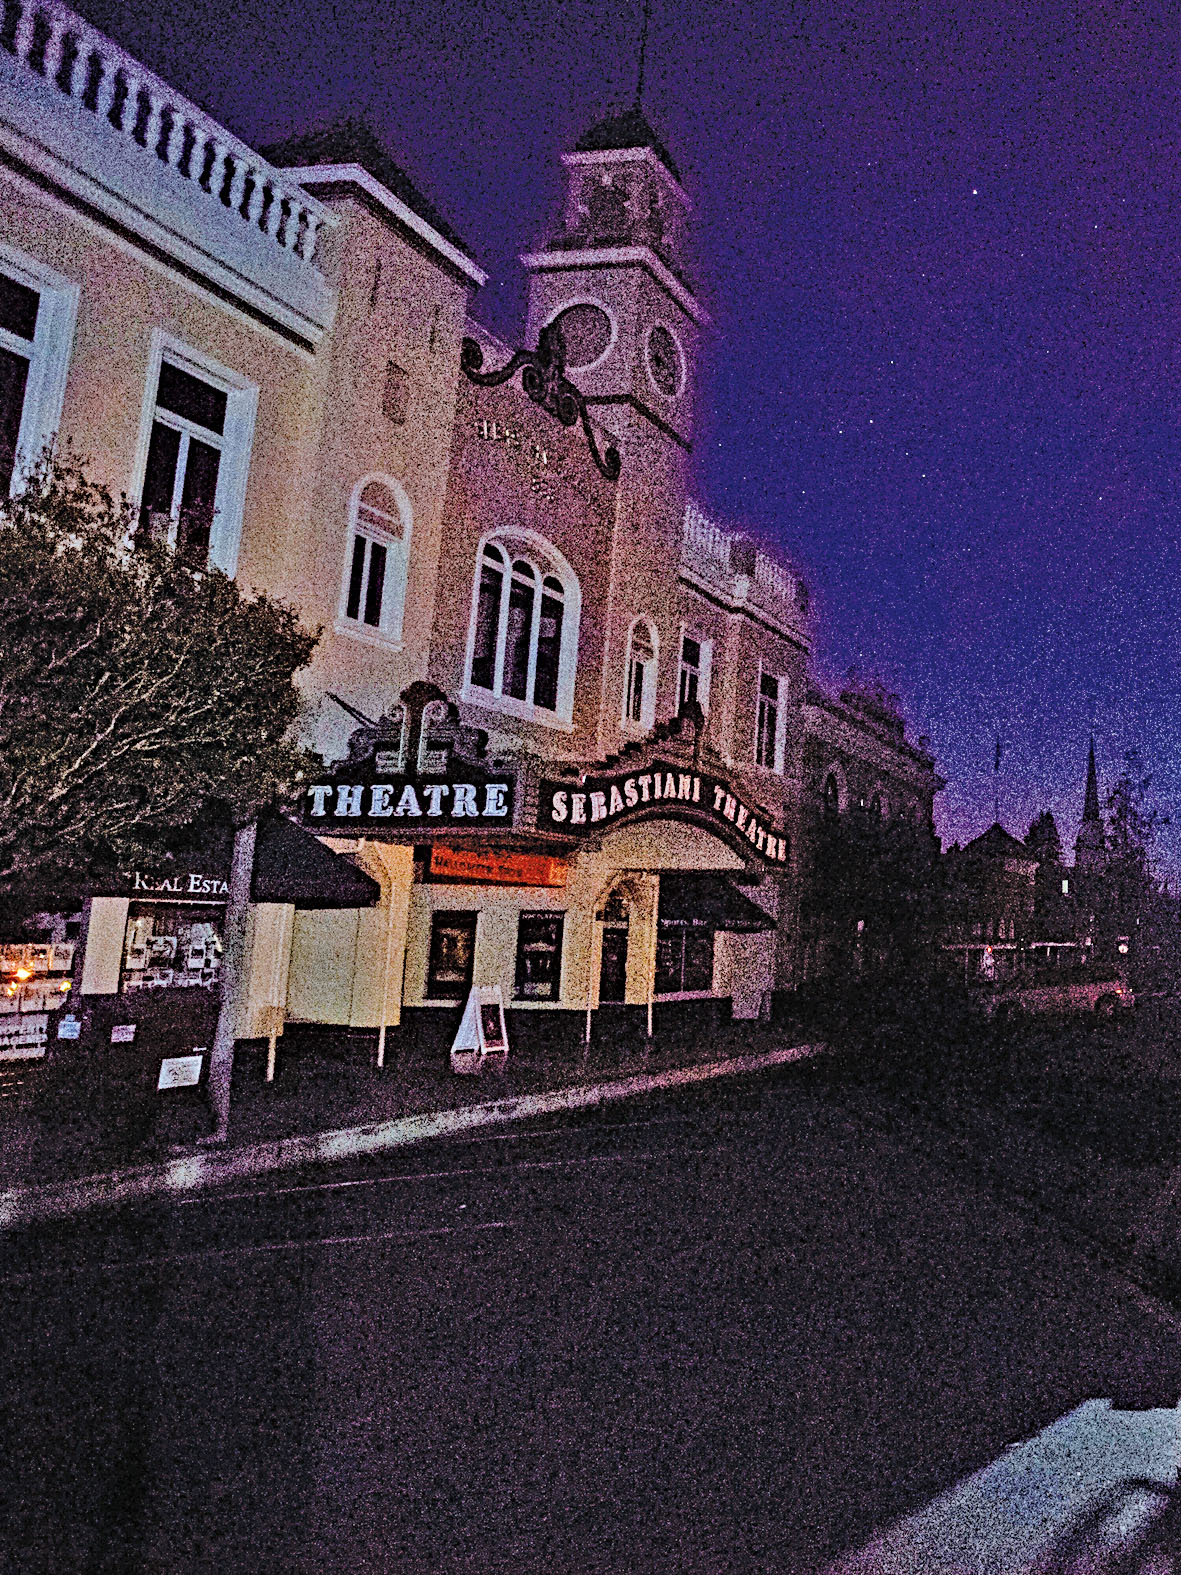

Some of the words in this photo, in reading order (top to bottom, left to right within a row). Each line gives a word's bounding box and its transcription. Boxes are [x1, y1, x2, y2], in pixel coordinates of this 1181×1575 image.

[307, 783, 509, 818] THEATRE
[551, 772, 700, 825] SEBASTIANI
[713, 784, 787, 862] THEATRE
[187, 873, 230, 894] ESTA
